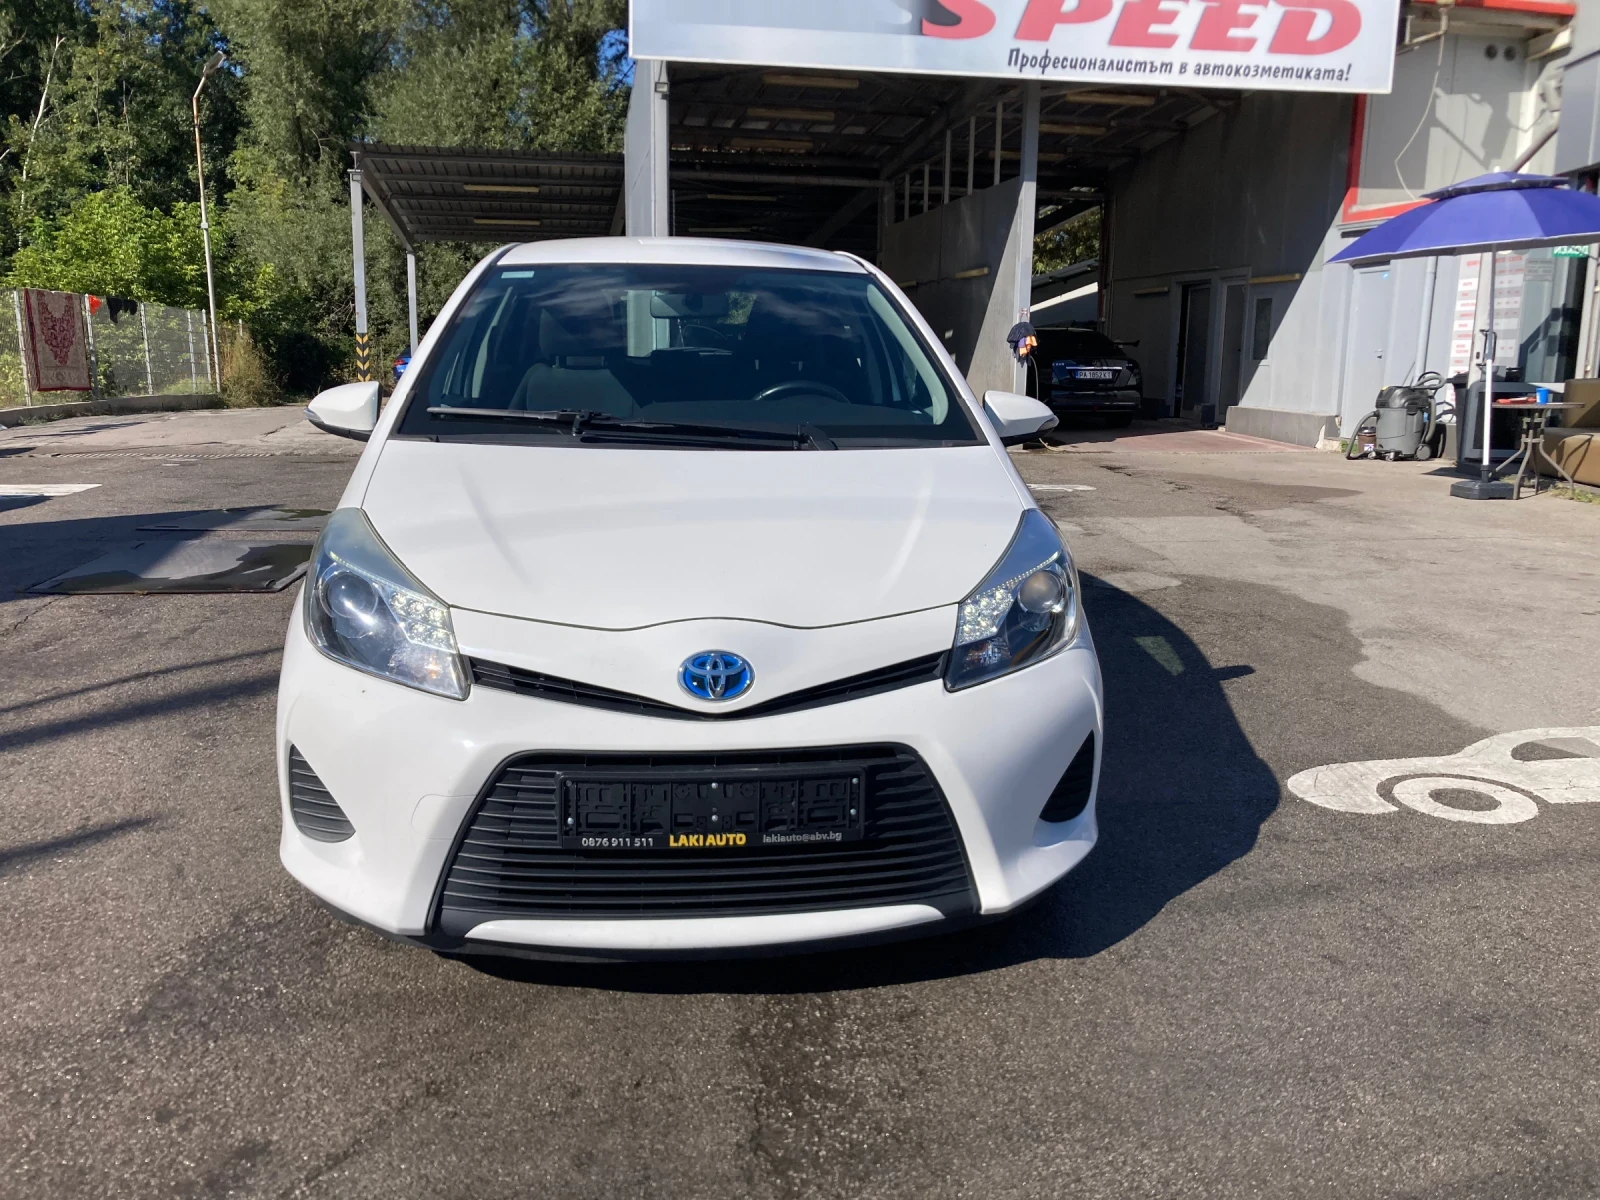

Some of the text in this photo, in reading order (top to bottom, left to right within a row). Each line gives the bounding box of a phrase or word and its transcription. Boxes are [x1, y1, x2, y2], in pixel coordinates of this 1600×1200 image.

[921, 0, 1362, 55] SPEED
[1007, 47, 1352, 82] Професионалистът в автокозметиката!
[581, 831, 842, 847] 0876 911 511 LAKI AUTO lakiauto@abv.bg
